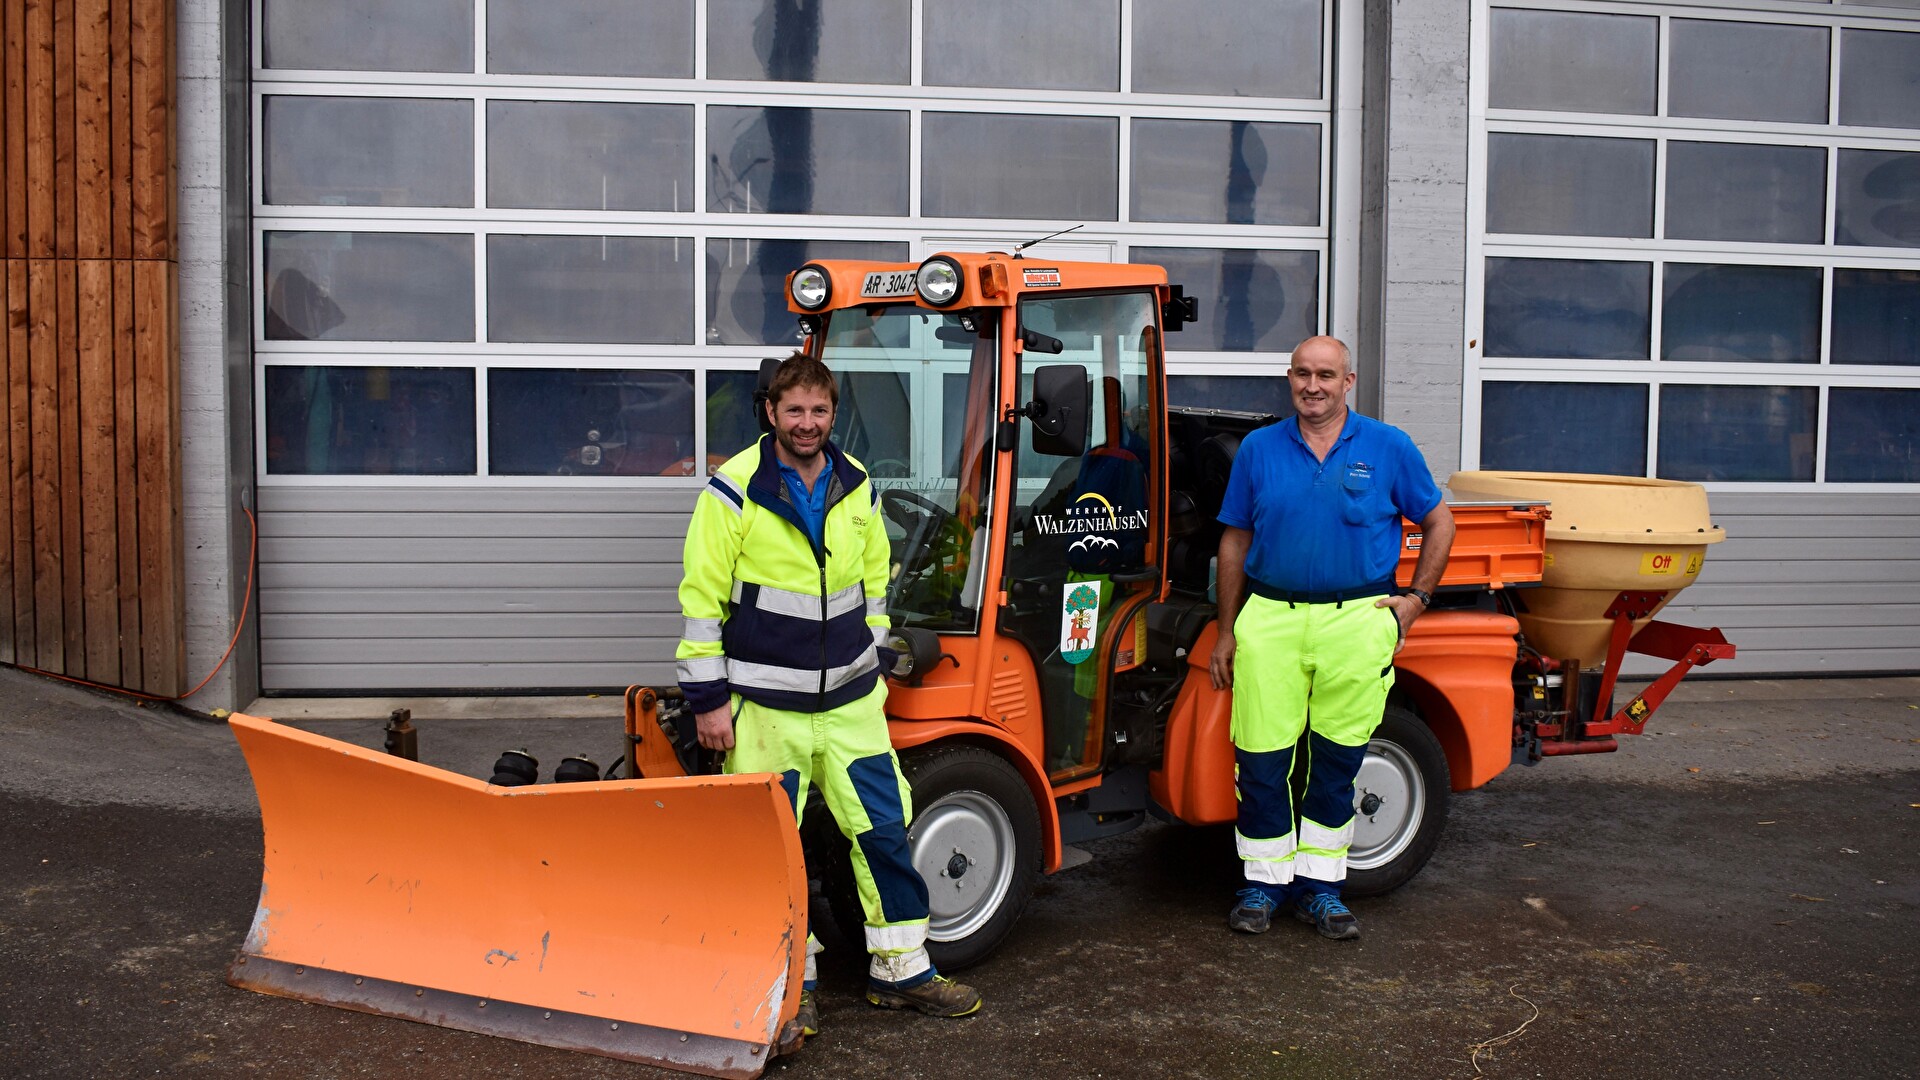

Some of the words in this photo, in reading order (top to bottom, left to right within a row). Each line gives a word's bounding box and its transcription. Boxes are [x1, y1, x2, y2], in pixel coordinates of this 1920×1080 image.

[1065, 505, 1122, 516] WERKHOF
[1034, 509, 1149, 535] WALZENHAUSEN
[1652, 554, 1672, 569] Ott
